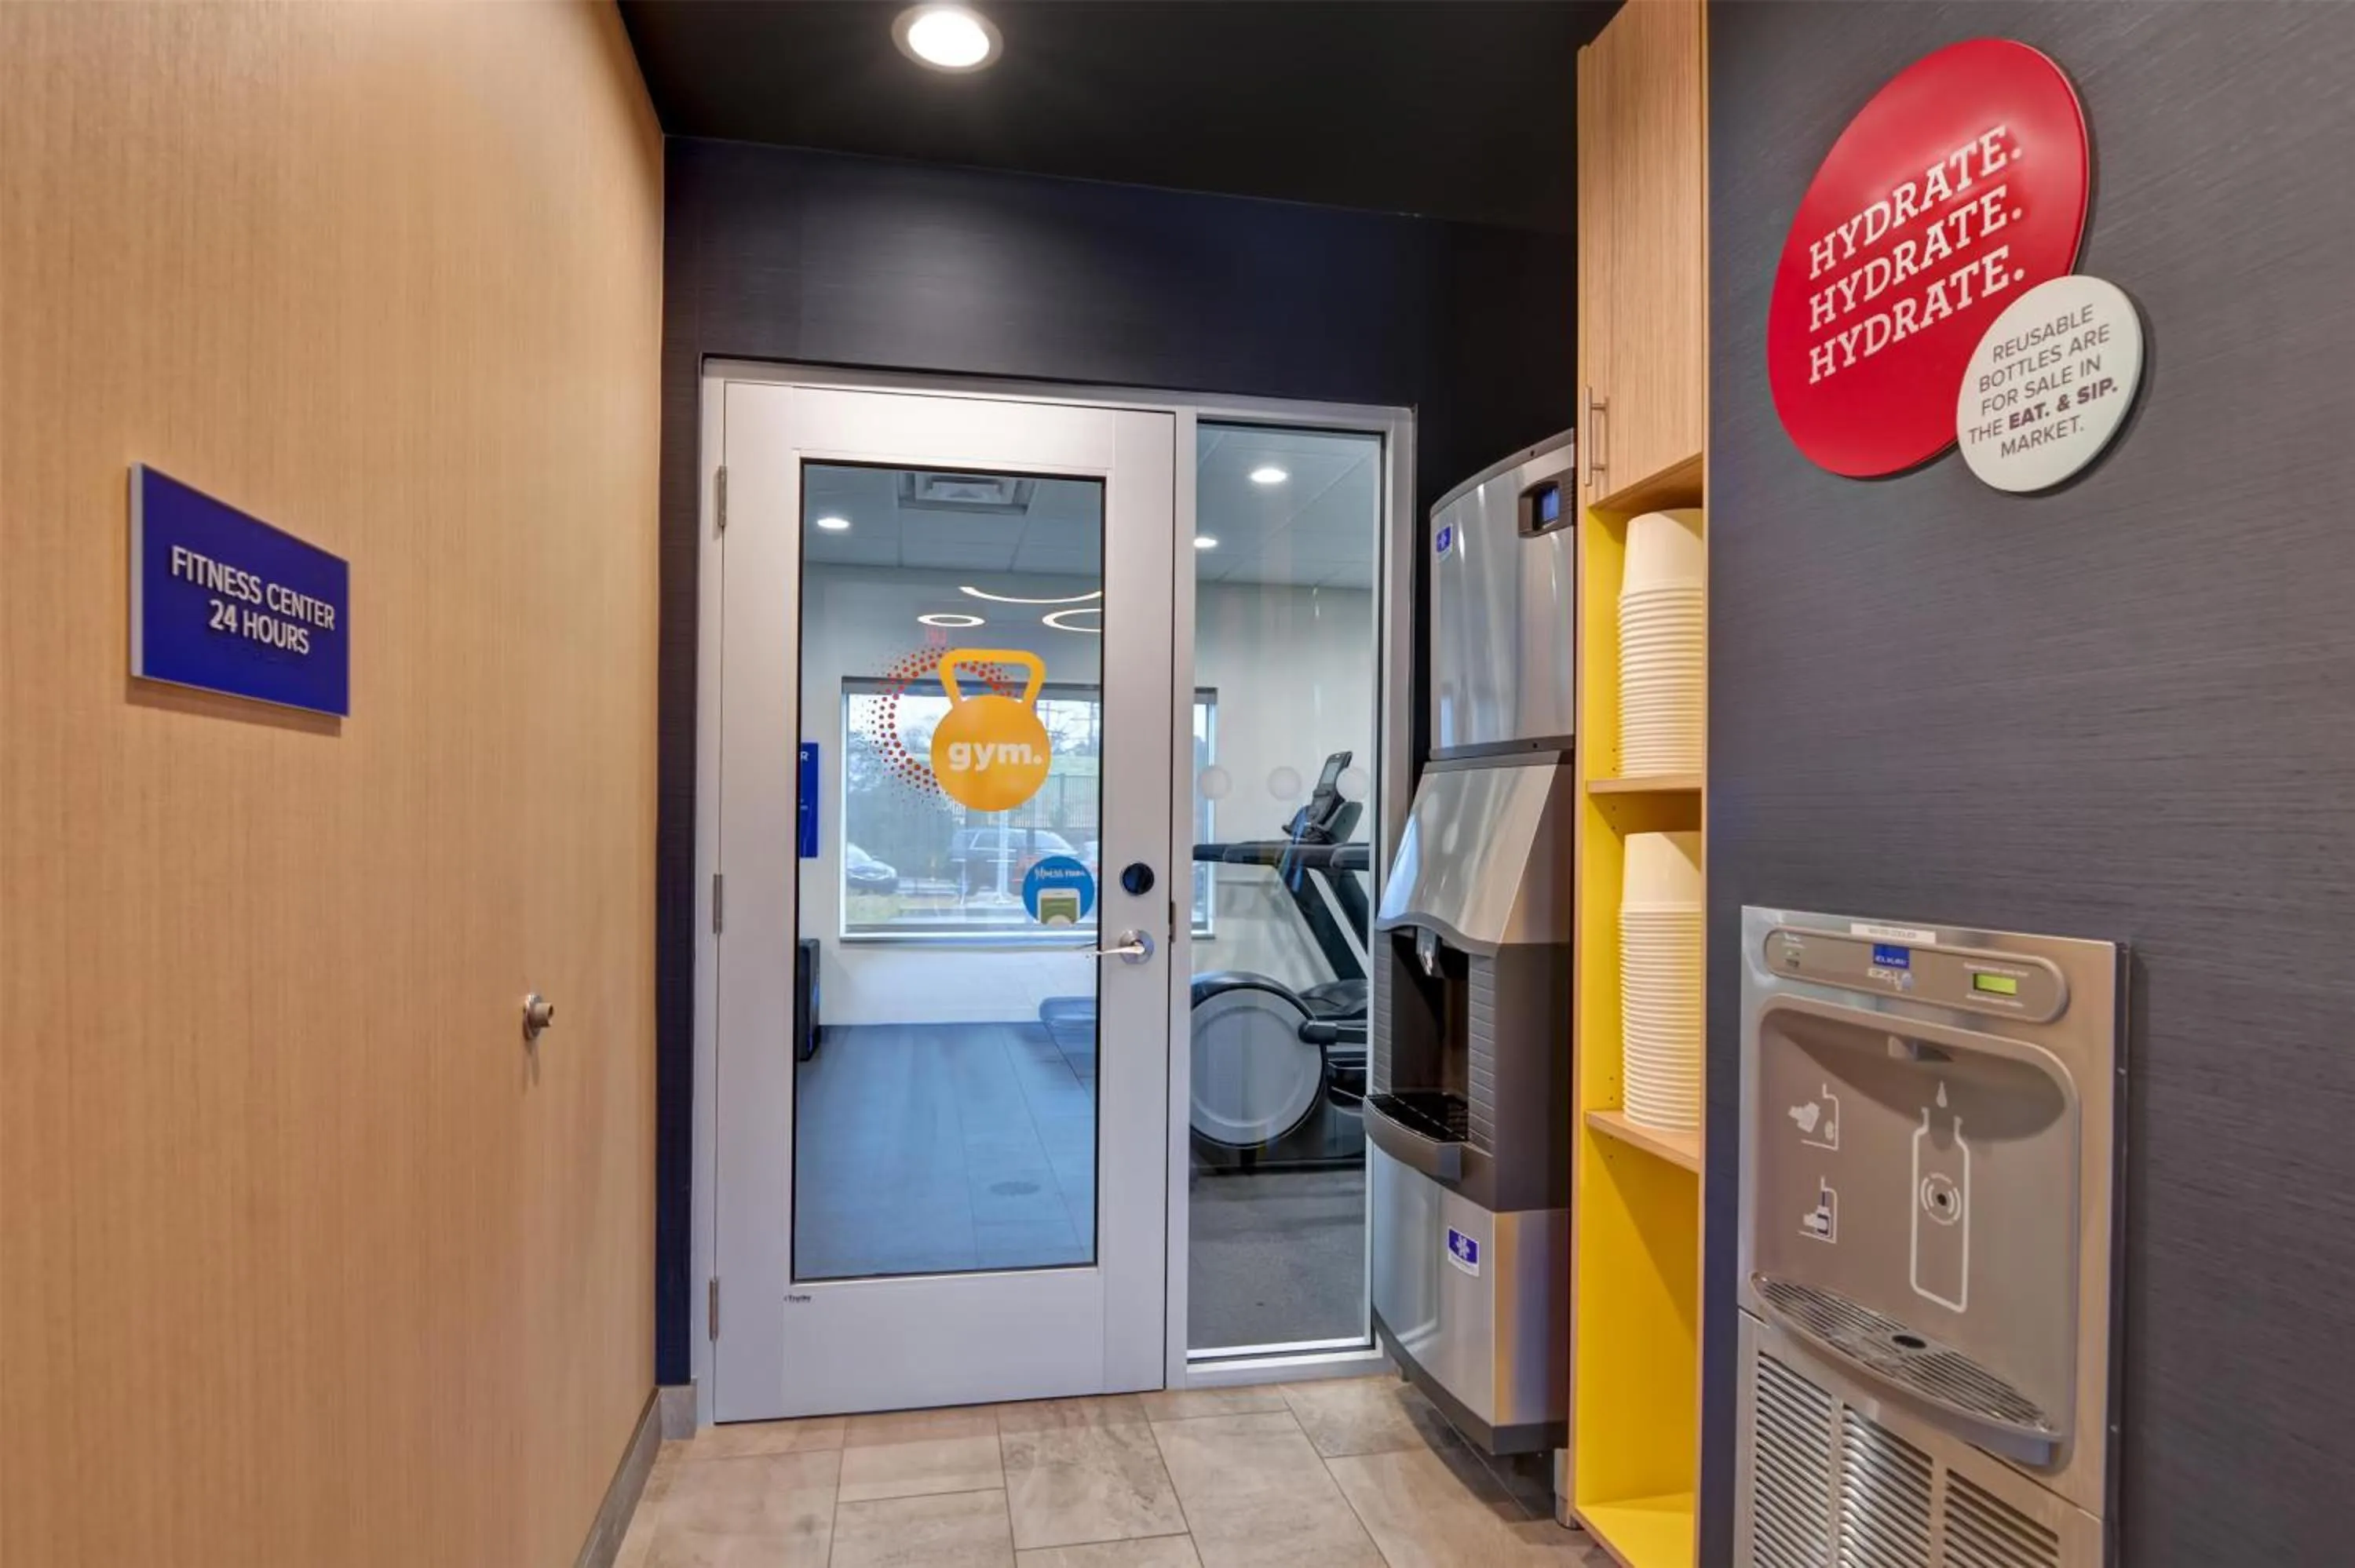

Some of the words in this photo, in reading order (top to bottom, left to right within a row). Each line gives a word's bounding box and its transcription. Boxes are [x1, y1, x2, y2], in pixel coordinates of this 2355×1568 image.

[1809, 125, 2023, 280] HYDRATE.
[1809, 184, 2023, 333] HYDRATE.
[1809, 245, 2025, 385] HYDRATE.
[1992, 303, 2094, 364] REUSABLE
[1979, 344, 2062, 394] BOTTLES
[2068, 323, 2110, 356] ARE
[1981, 388, 2018, 417] FOR
[2025, 365, 2073, 399] SALE
[2080, 354, 2101, 378] IN
[1968, 418, 2003, 445] THE
[2009, 402, 2050, 431] EAT.
[2057, 393, 2070, 413] &
[2076, 377, 2118, 405] SIP.
[2000, 414, 2084, 459] MARKET.
[171, 545, 262, 605] FITNESS
[266, 582, 335, 631] CENTER
[209, 599, 238, 634] 24
[243, 609, 310, 655] HOURS
[947, 742, 1043, 771] gym.
